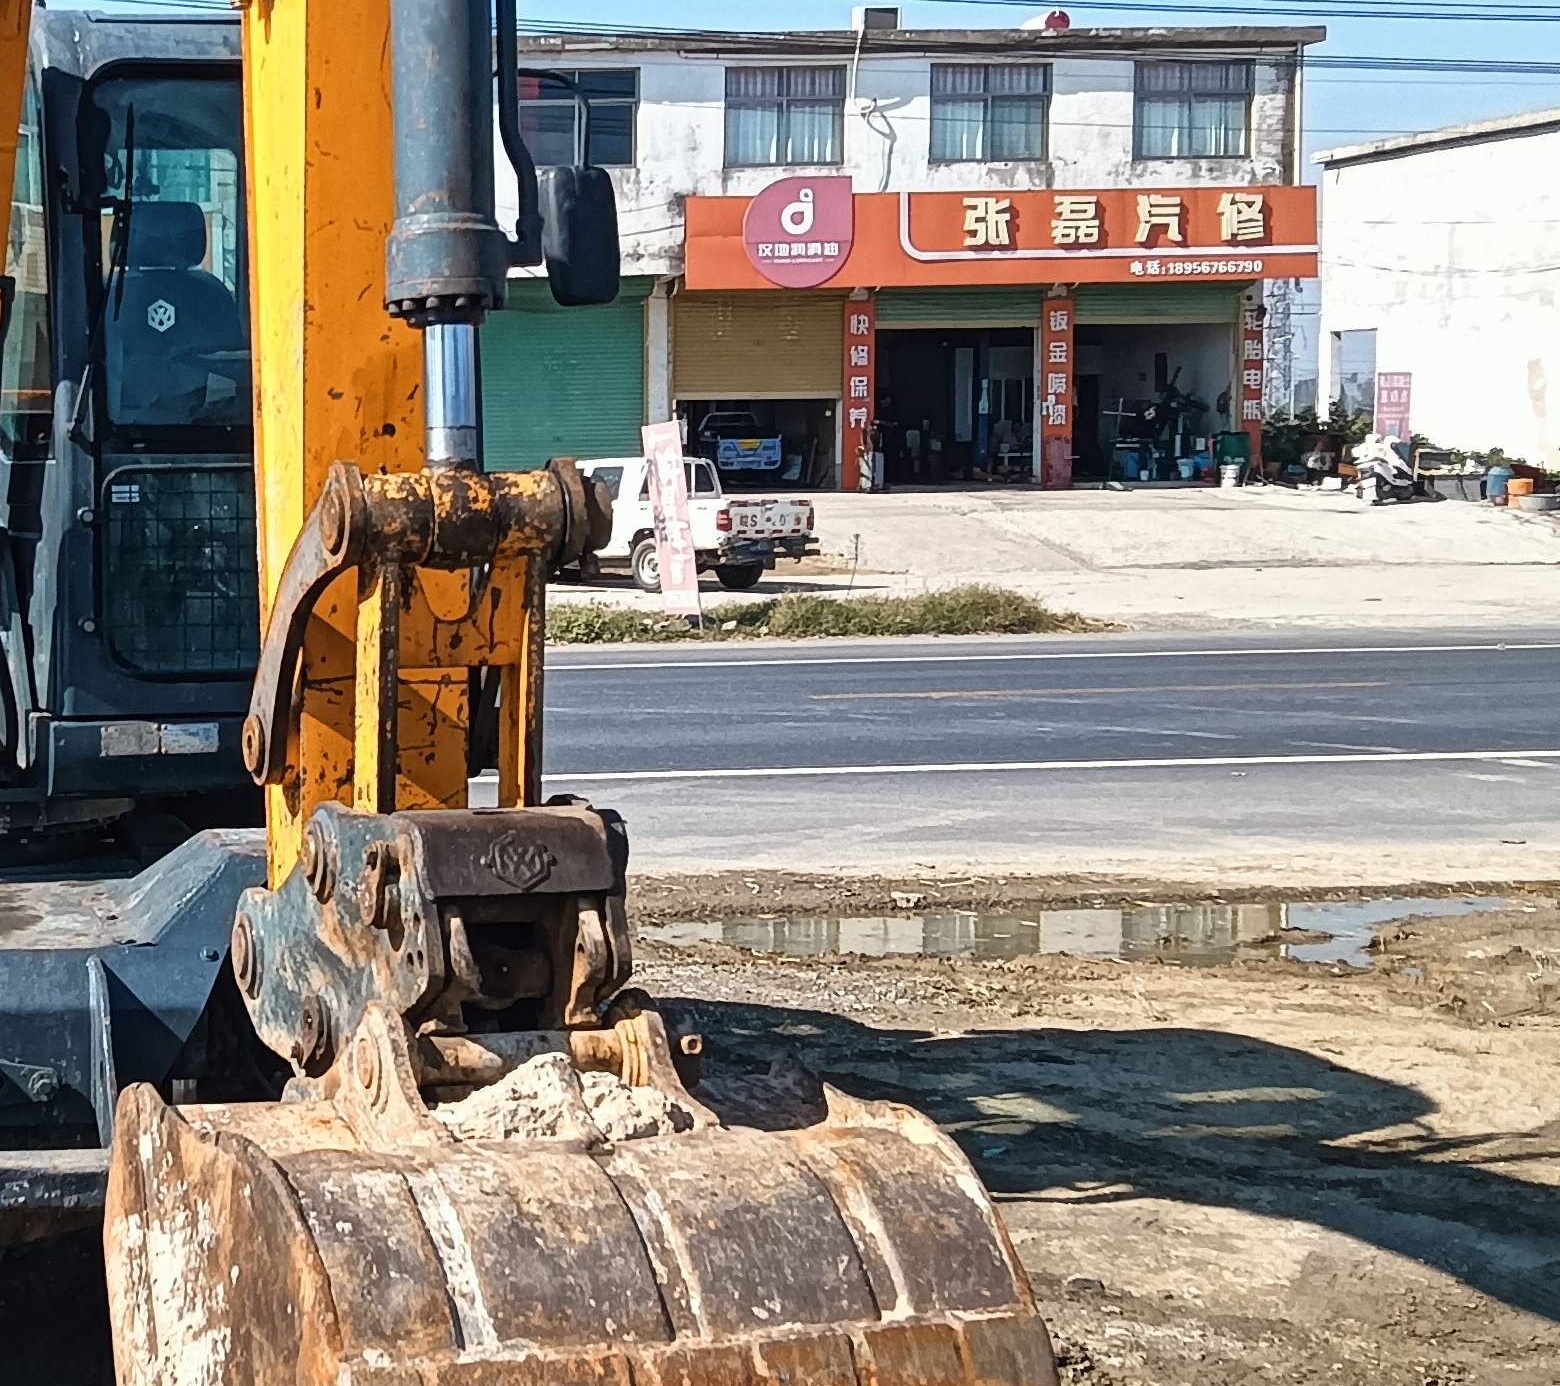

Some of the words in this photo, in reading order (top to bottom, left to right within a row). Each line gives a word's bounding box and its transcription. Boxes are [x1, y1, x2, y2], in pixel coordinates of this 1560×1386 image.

[962, 193, 1265, 246] 张磊汽修
[849, 314, 870, 428] 快修保养
[1048, 311, 1069, 425] 钣金喷漆
